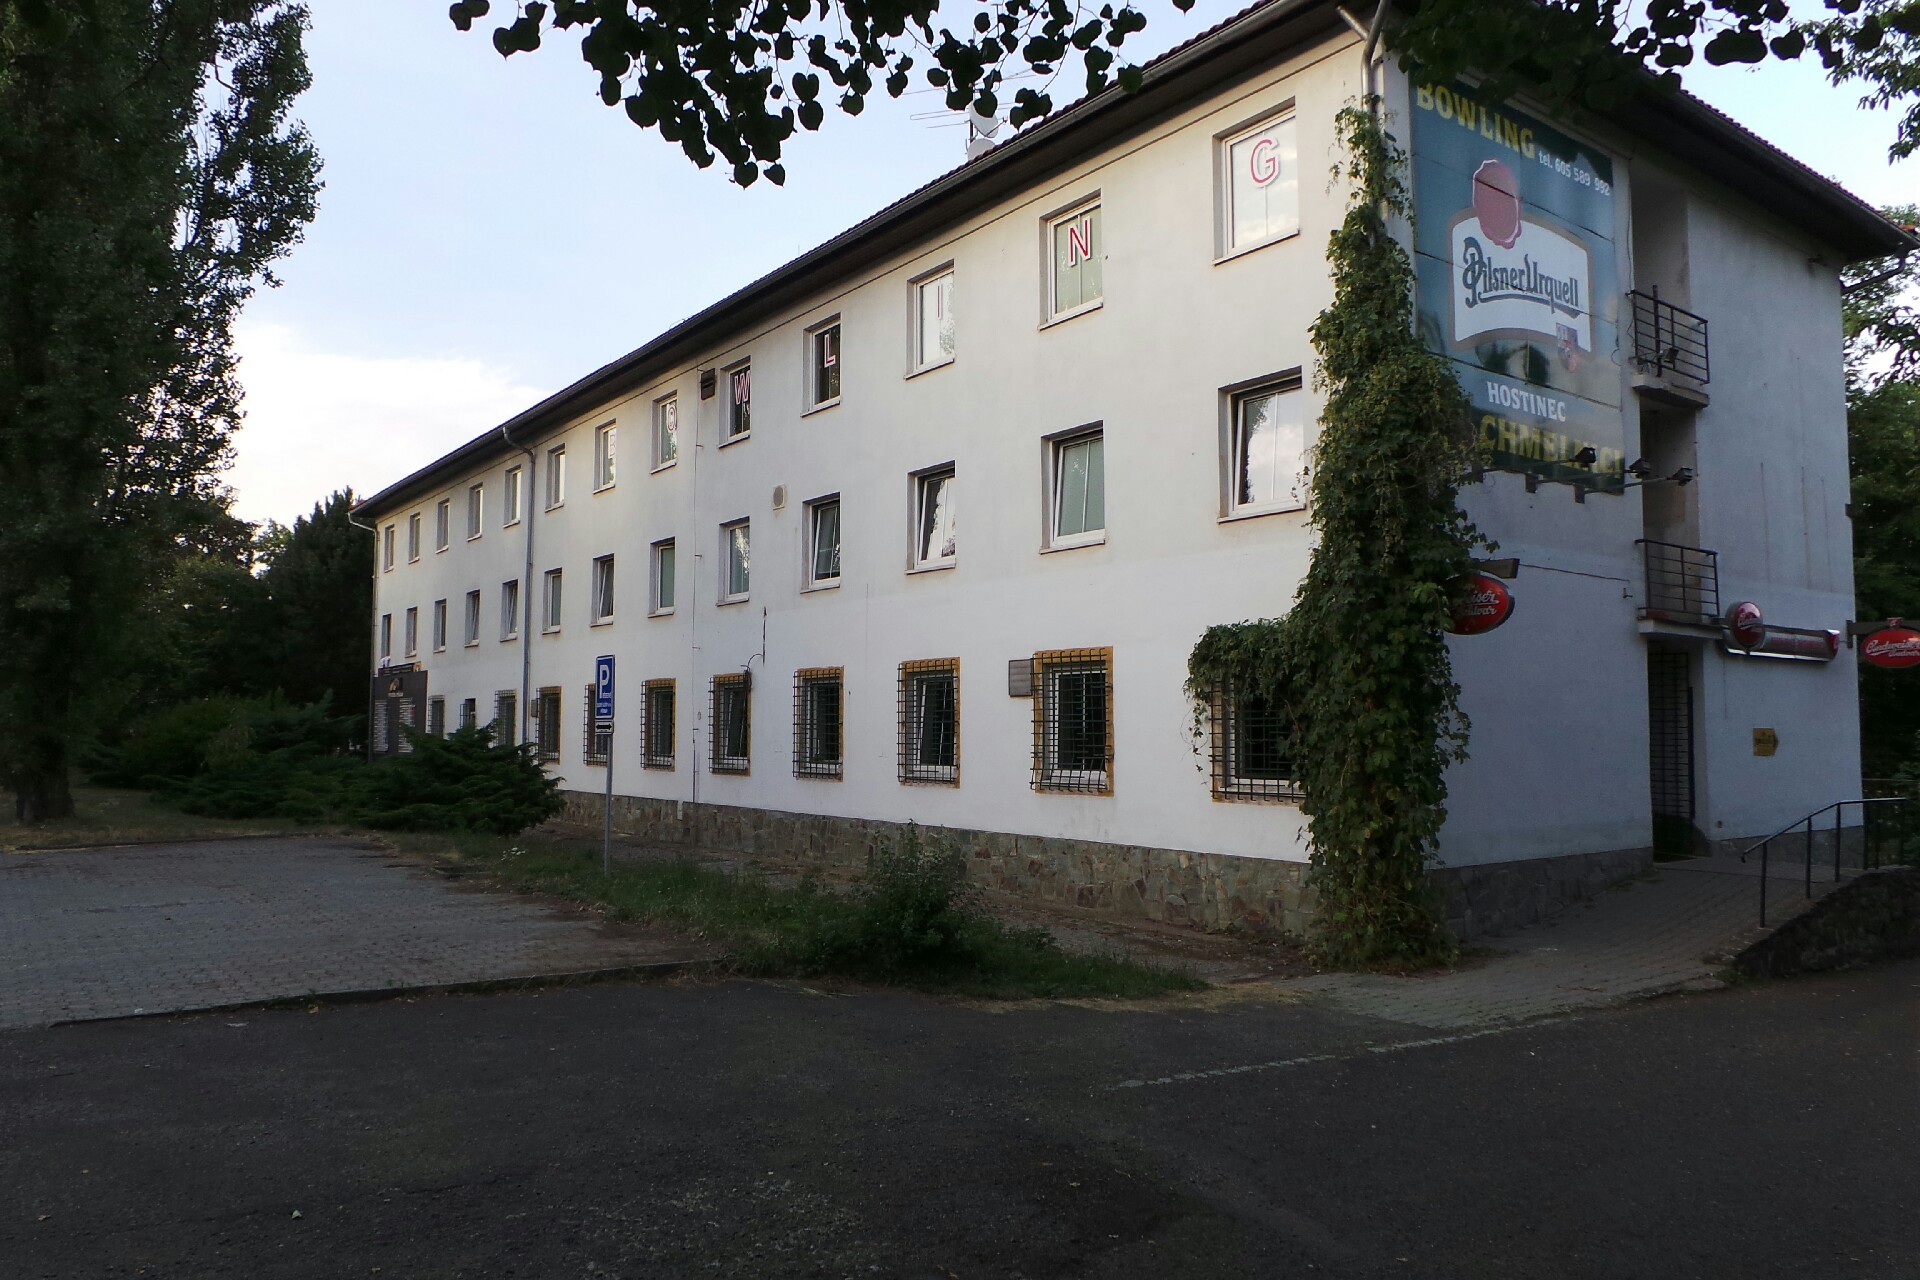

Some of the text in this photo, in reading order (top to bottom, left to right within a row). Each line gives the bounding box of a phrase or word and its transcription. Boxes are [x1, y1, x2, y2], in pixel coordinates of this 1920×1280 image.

[1417, 82, 1536, 159] BOWLING
[1538, 150, 1553, 169] tel.
[1555, 158, 1572, 178] 605
[1573, 167, 1591, 187] 589
[1067, 217, 1092, 267] N
[1250, 138, 1280, 187] G
[1462, 236, 1579, 314] Pilsner Urquell
[1487, 381, 1567, 423] HOSTINEC
[599, 664, 610, 699] P
